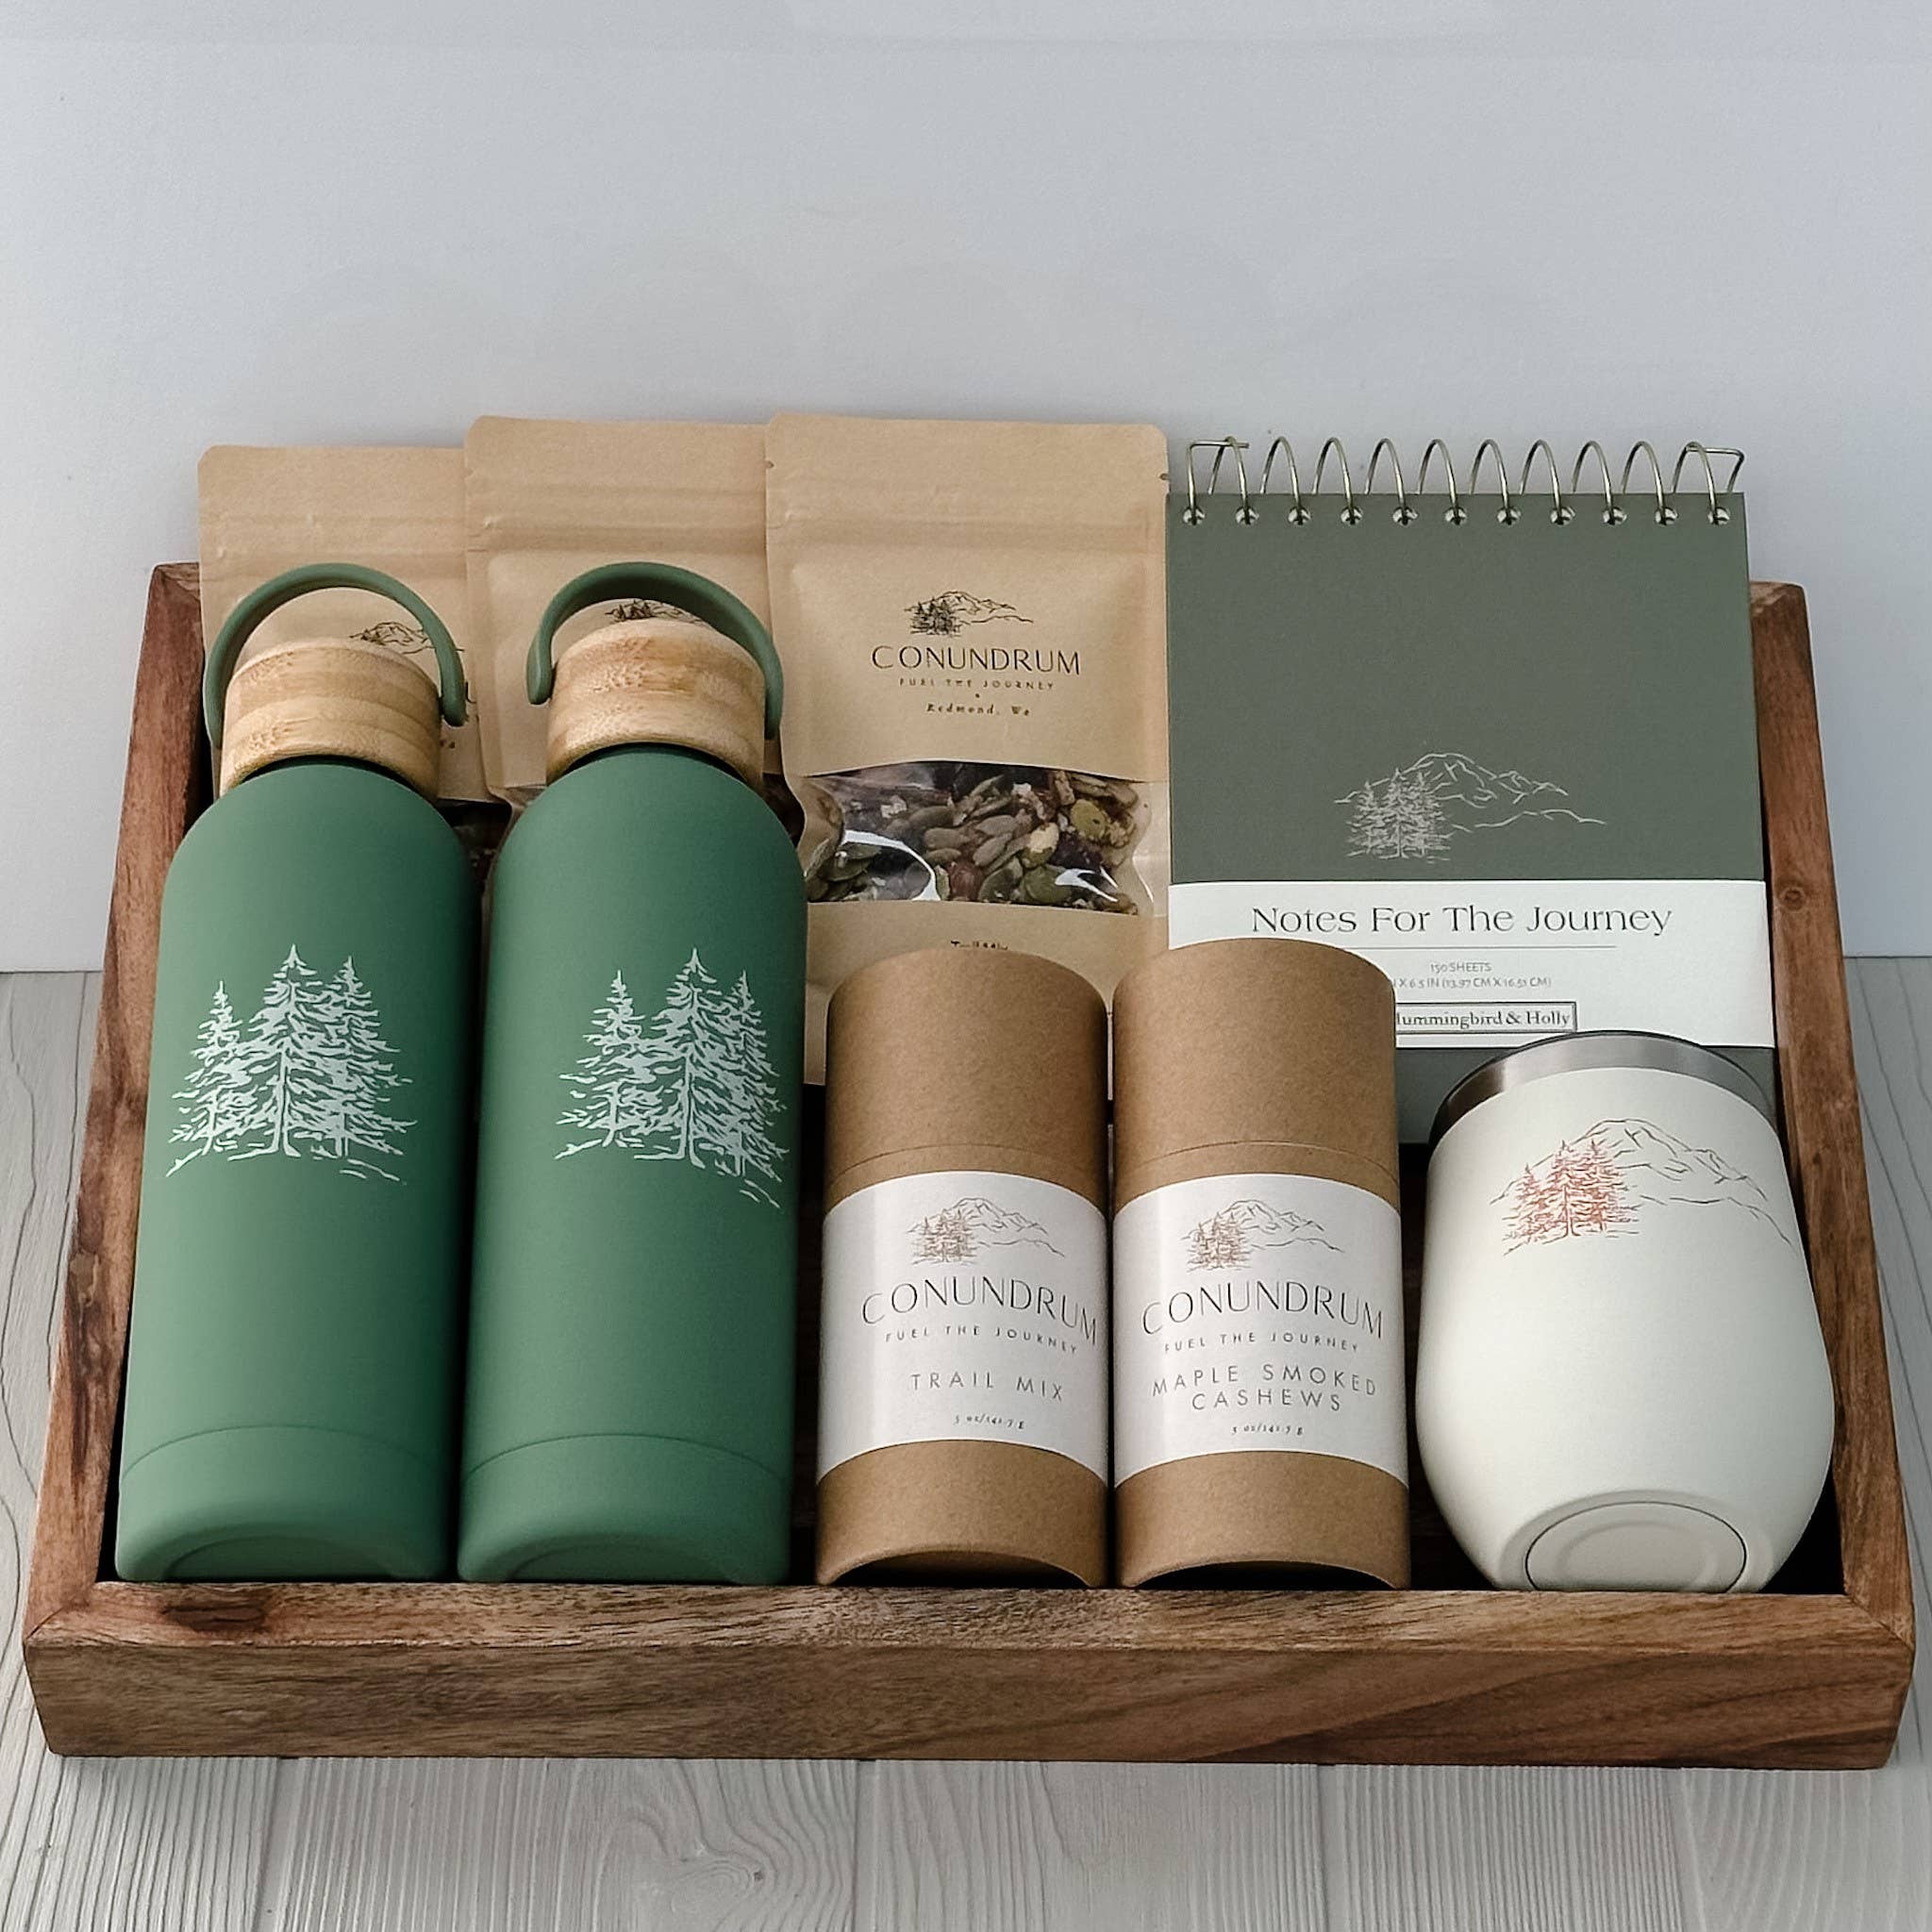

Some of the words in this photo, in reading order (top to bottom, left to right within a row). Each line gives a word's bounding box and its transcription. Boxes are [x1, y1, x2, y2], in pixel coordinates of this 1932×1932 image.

[872, 645, 1080, 675] CONUNDRUM
[983, 679, 1054, 690] JOURNEY
[1252, 908, 1357, 933] Notes
[1372, 908, 1431, 932] For
[1441, 905, 1514, 932] The
[1526, 907, 1672, 936] Journey
[1426, 977, 1440, 988] IN
[1473, 977, 1491, 988] CM
[1529, 977, 1552, 988] CM)
[1430, 963, 1448, 974] 150
[1449, 962, 1492, 972] SHEETS
[1506, 1014, 1522, 1025] &
[1526, 1010, 1571, 1028] Holly
[861, 1275, 1097, 1345] CONUNDRUM
[1142, 1280, 1383, 1340] CONUNDRUM
[885, 1328, 928, 1342] FUEL
[945, 1325, 981, 1337] THE
[994, 1326, 1077, 1354] JOURNEY
[1164, 1338, 1206, 1353] FUEL
[1220, 1332, 1257, 1344] THE
[1272, 1331, 1359, 1352] JOURNEY
[911, 1372, 993, 1391] TRAIL
[1016, 1376, 1063, 1401] MIX
[1152, 1365, 1240, 1397] MAPLE
[1262, 1363, 1376, 1396] SMOKED
[1191, 1388, 1341, 1412] CASHEWS
